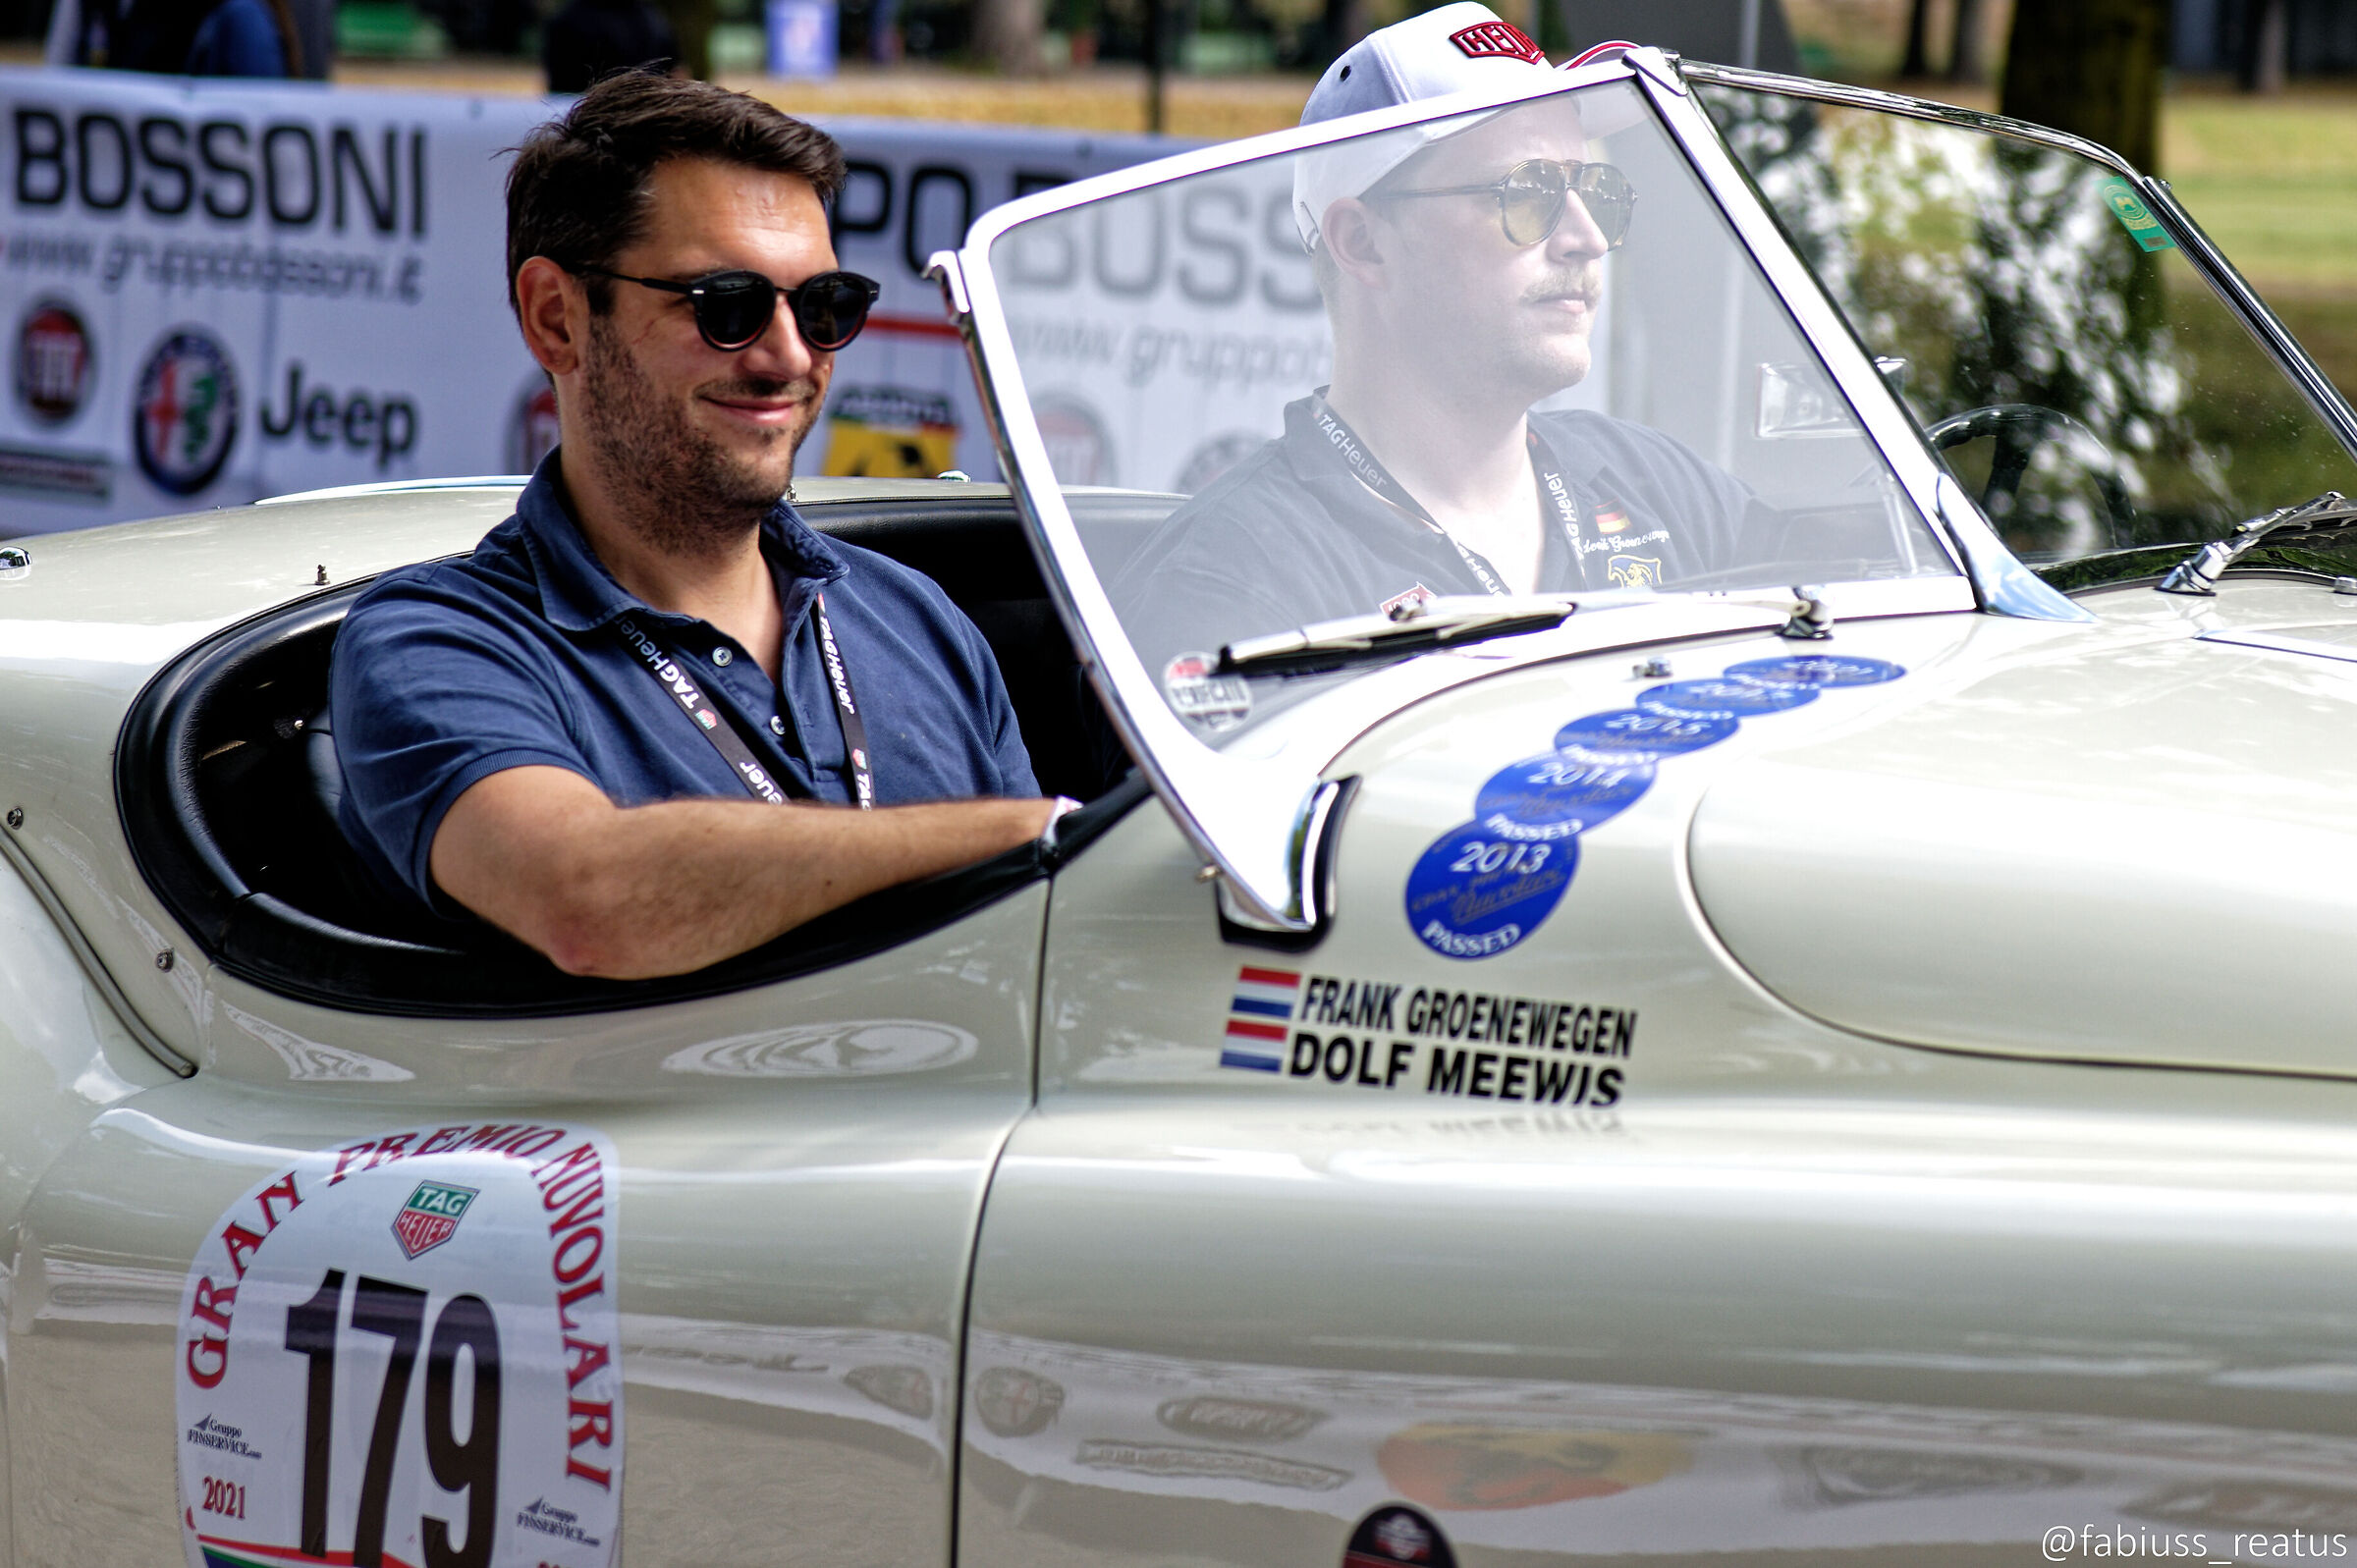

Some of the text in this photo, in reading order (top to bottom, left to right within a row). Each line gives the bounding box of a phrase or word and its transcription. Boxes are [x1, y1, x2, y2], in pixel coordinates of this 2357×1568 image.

[13, 109, 430, 240] BOSSONI
[1008, 171, 1328, 312] BOSS
[259, 355, 419, 469] Jeep
[1449, 840, 1552, 874] 2013
[1423, 918, 1521, 957] PASSED
[1300, 976, 1638, 1058] FRANK GROENEWEGEN
[1288, 1030, 1626, 1108] DOLF MEEWIS
[400, 1214, 454, 1250] HEUER
[416, 1187, 468, 1214] TAG
[186, 1123, 613, 1492] GRAN PREMIO NUVOLARI
[209, 1419, 243, 1439] Gruppo
[285, 1267, 502, 1568] 179
[201, 1475, 247, 1522] 2021
